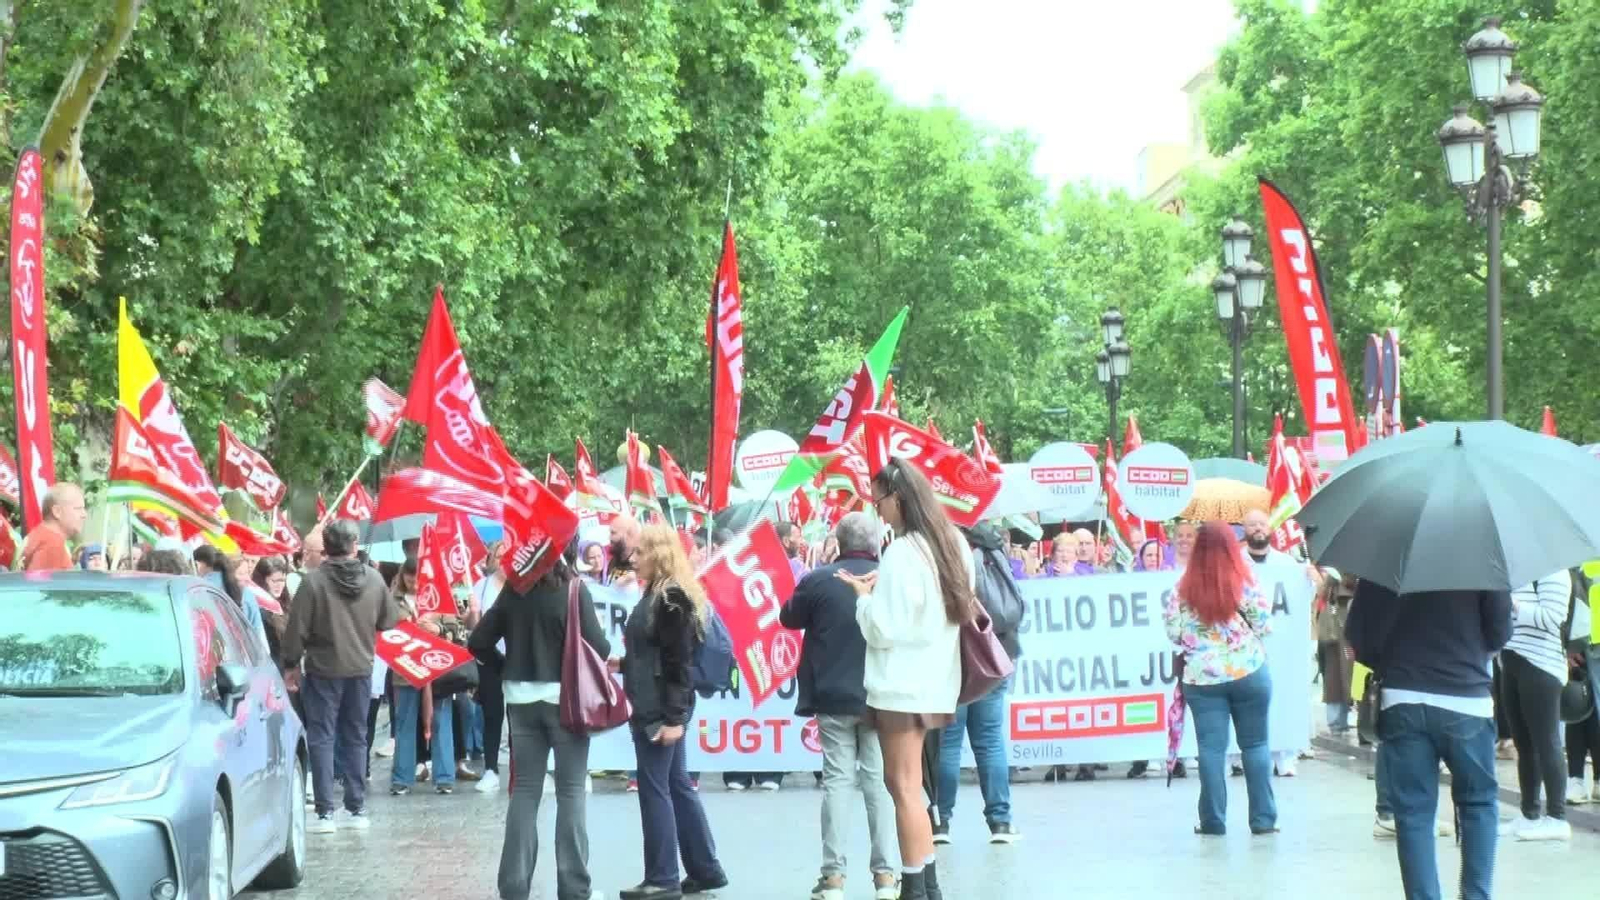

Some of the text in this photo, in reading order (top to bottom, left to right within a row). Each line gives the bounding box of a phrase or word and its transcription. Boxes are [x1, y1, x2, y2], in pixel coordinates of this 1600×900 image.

[1128, 468, 1171, 483] CCOO
[727, 537, 782, 631] UGT
[1108, 592, 1150, 628] DE
[1016, 703, 1118, 732] CCOO
[699, 719, 791, 754] UGT
[1012, 742, 1064, 760] Sevilla
